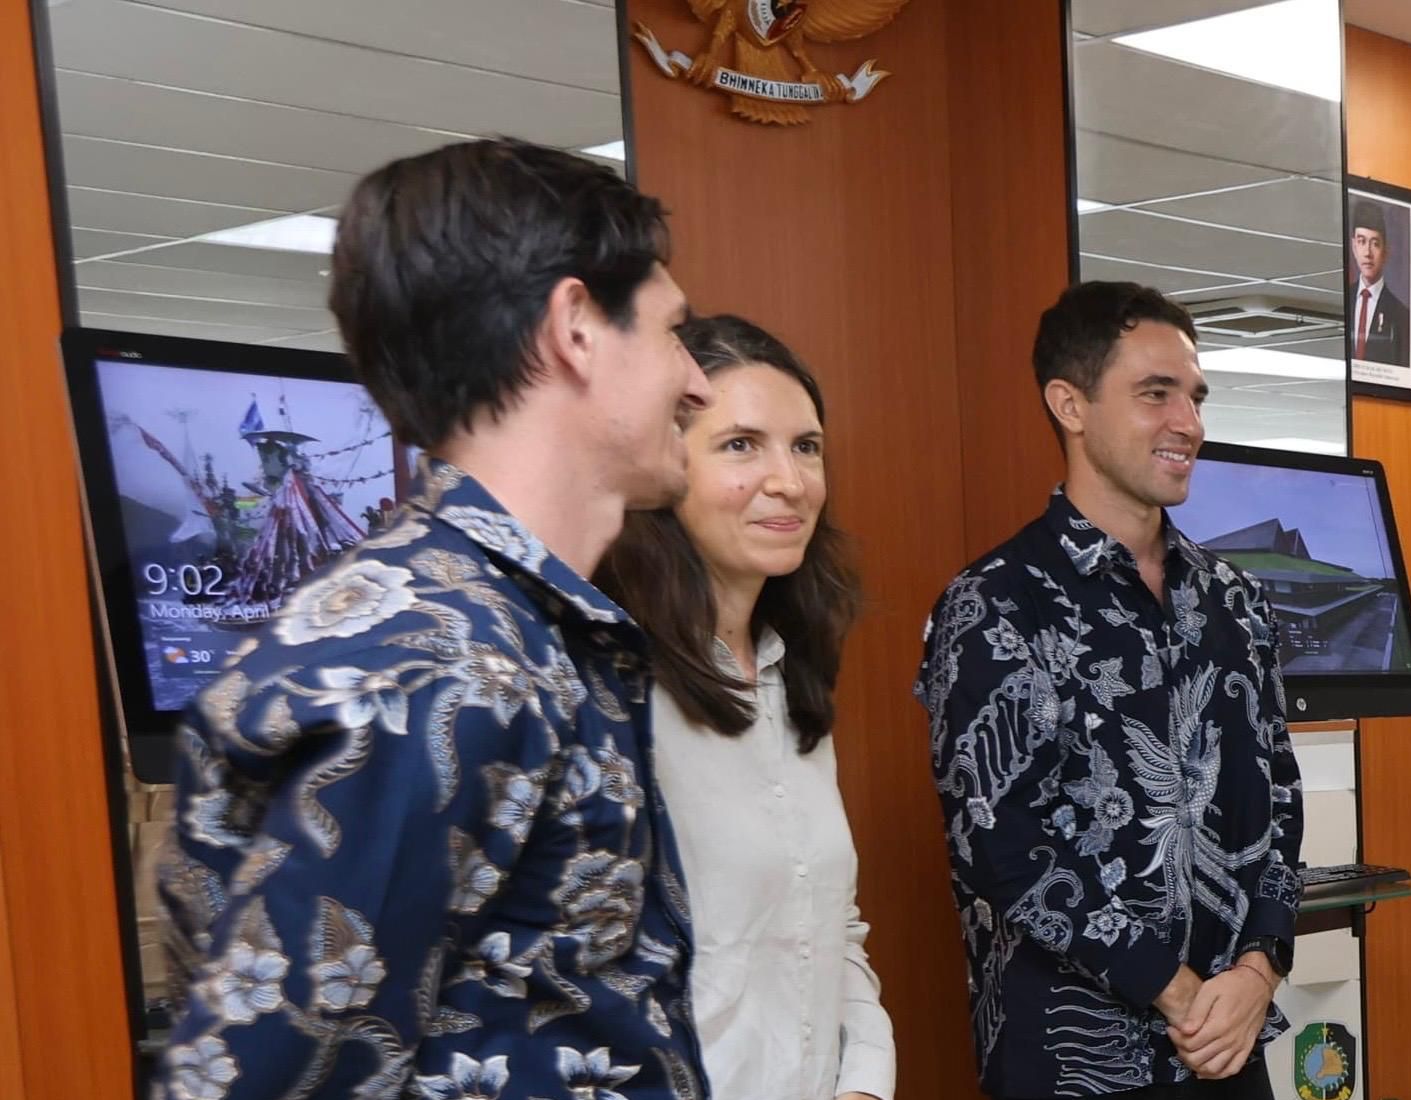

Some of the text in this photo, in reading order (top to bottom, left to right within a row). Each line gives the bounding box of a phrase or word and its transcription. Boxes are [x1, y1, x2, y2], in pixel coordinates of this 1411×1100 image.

[719, 71, 775, 97] BHINNEKA
[145, 563, 226, 596] 9:02
[151, 603, 270, 623] Monday, April
